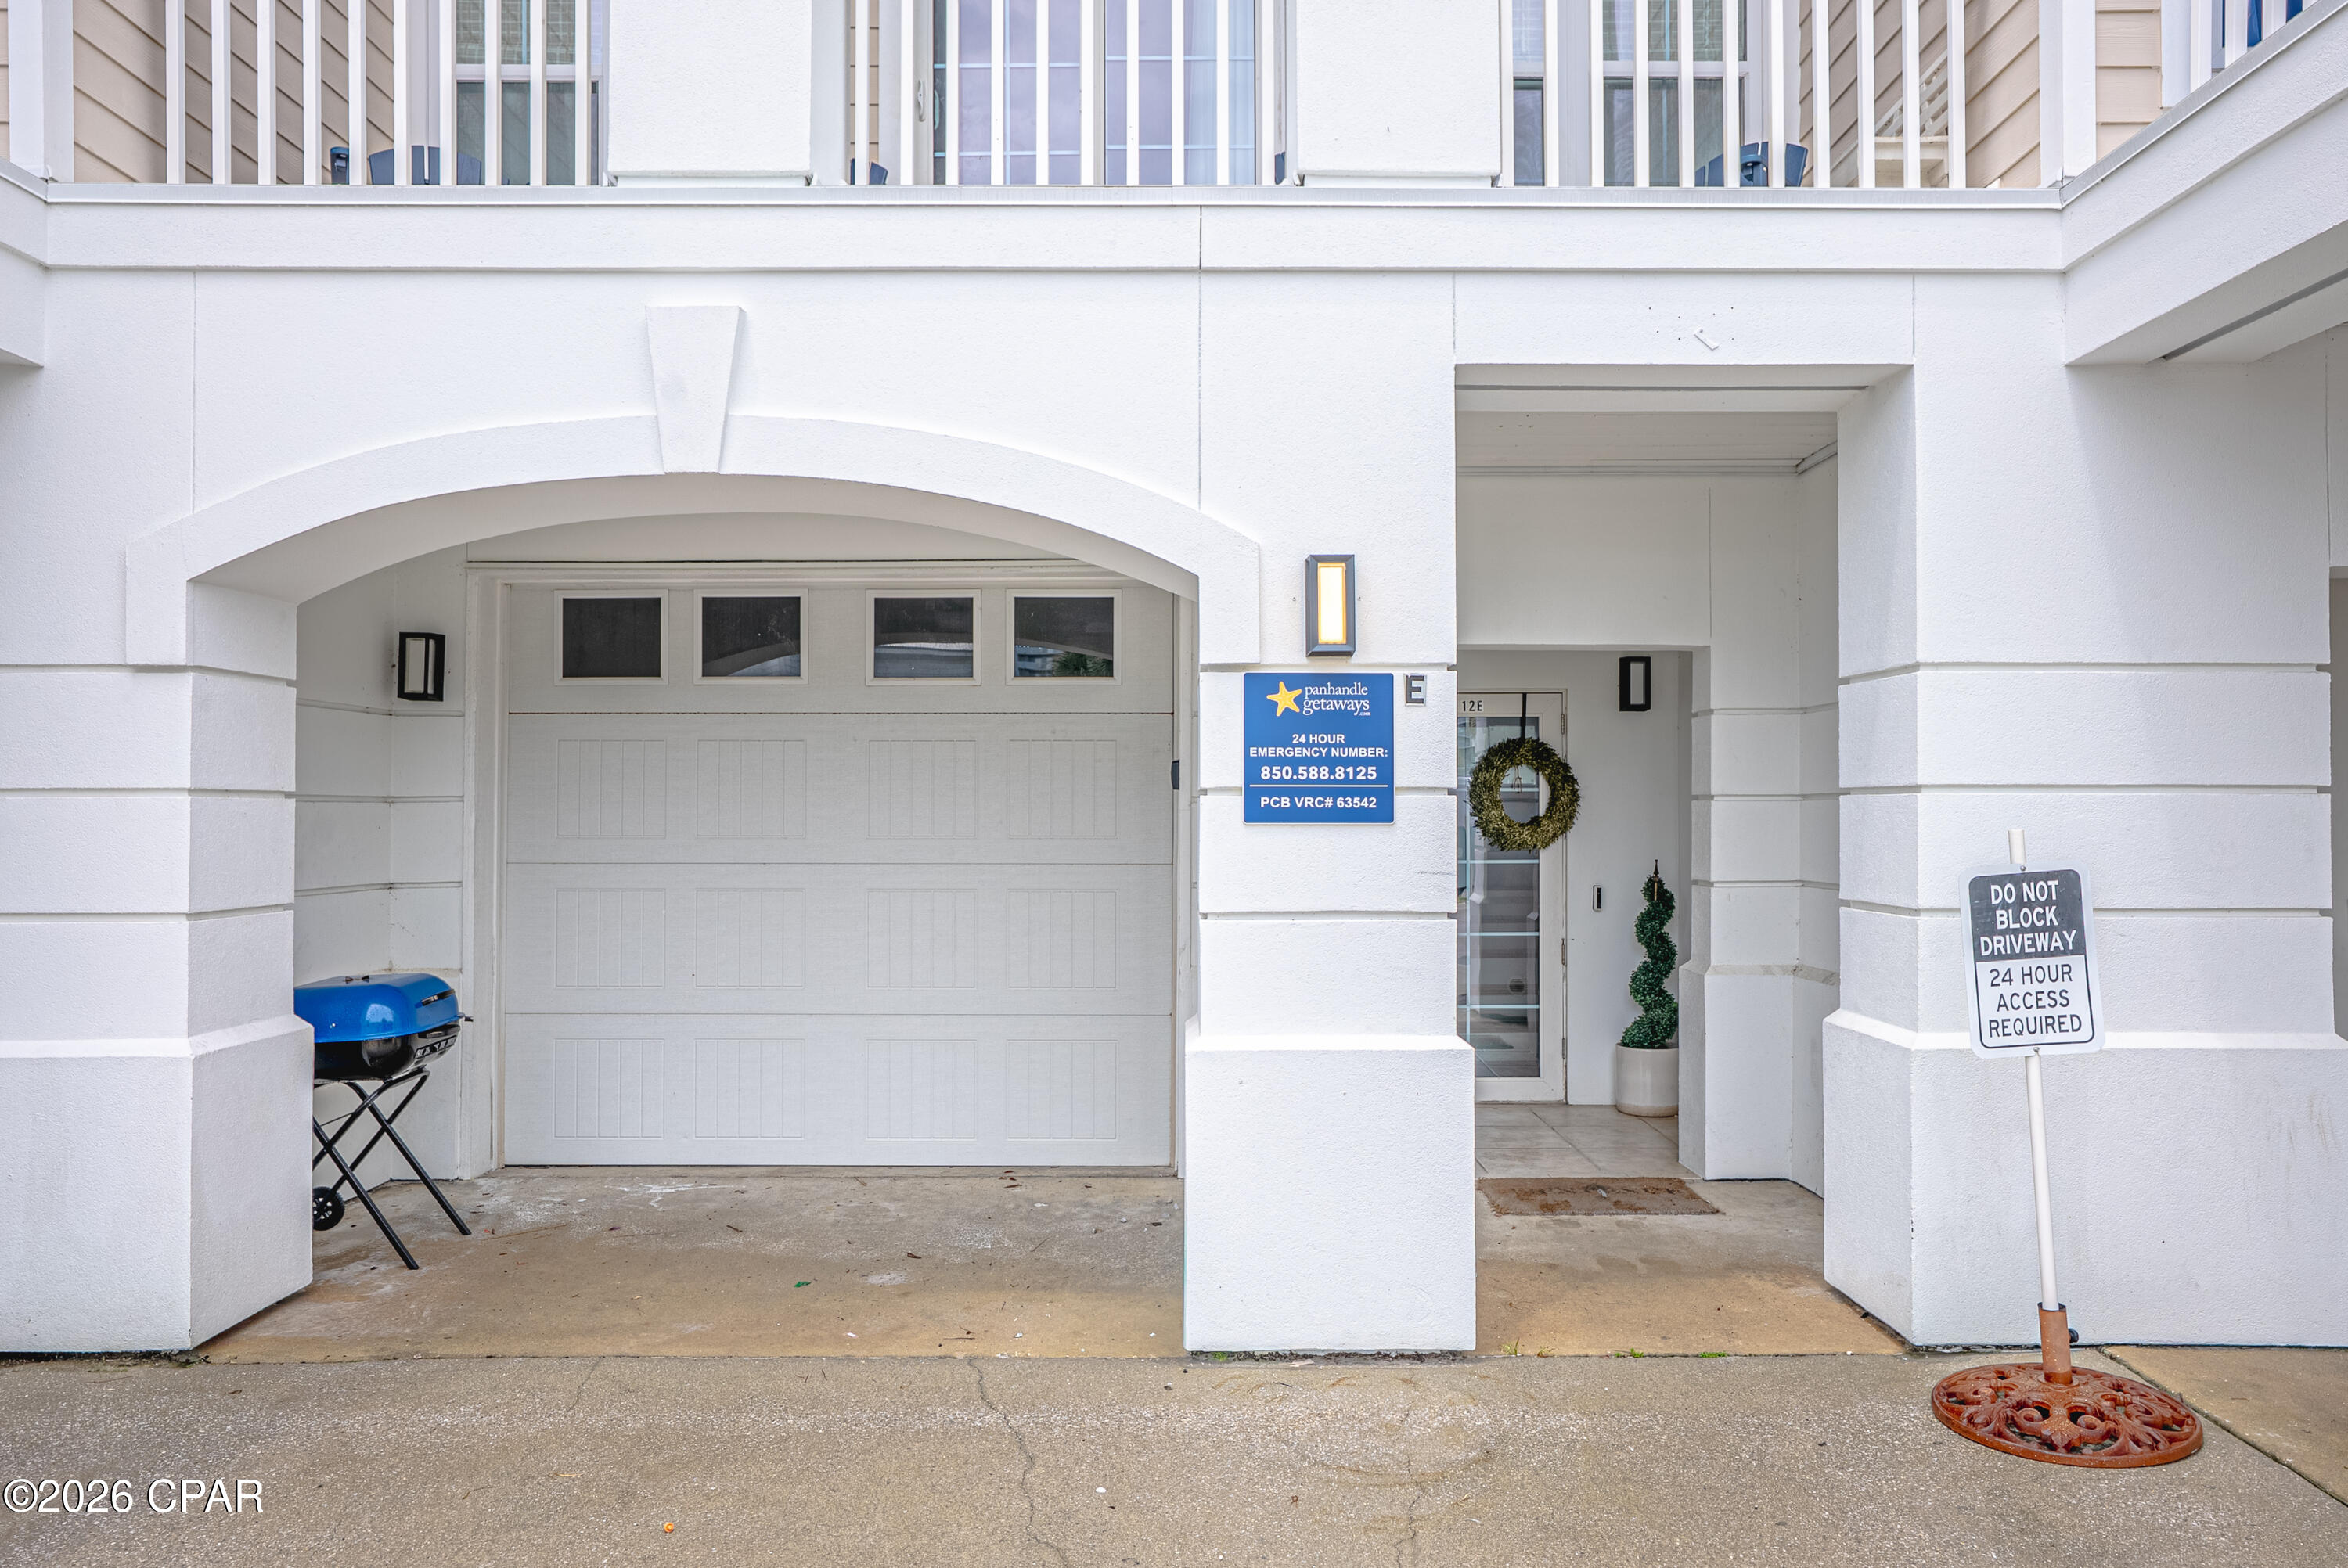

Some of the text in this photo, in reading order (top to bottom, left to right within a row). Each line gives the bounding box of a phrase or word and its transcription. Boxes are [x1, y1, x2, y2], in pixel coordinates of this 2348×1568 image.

[1305, 682, 1368, 699] panhandle
[1406, 675, 1424, 704] E
[1302, 697, 1370, 716] getaways
[1462, 700, 1482, 711] 12E
[1292, 734, 1345, 743] 24 HOUR
[1250, 747, 1388, 757] EMERGENCY NUMBER:
[1260, 766, 1377, 780] 850.588.8125
[1260, 797, 1377, 807] PCB VRC# 63542
[1990, 880, 2058, 904] DO NOT
[1996, 906, 2058, 930] BLOCK
[1980, 930, 2076, 955] DRIVEWAY
[1990, 964, 2073, 987] 24 HOUR
[1997, 989, 2069, 1012] ACCESS
[1989, 1014, 2082, 1038] REQUIRED
